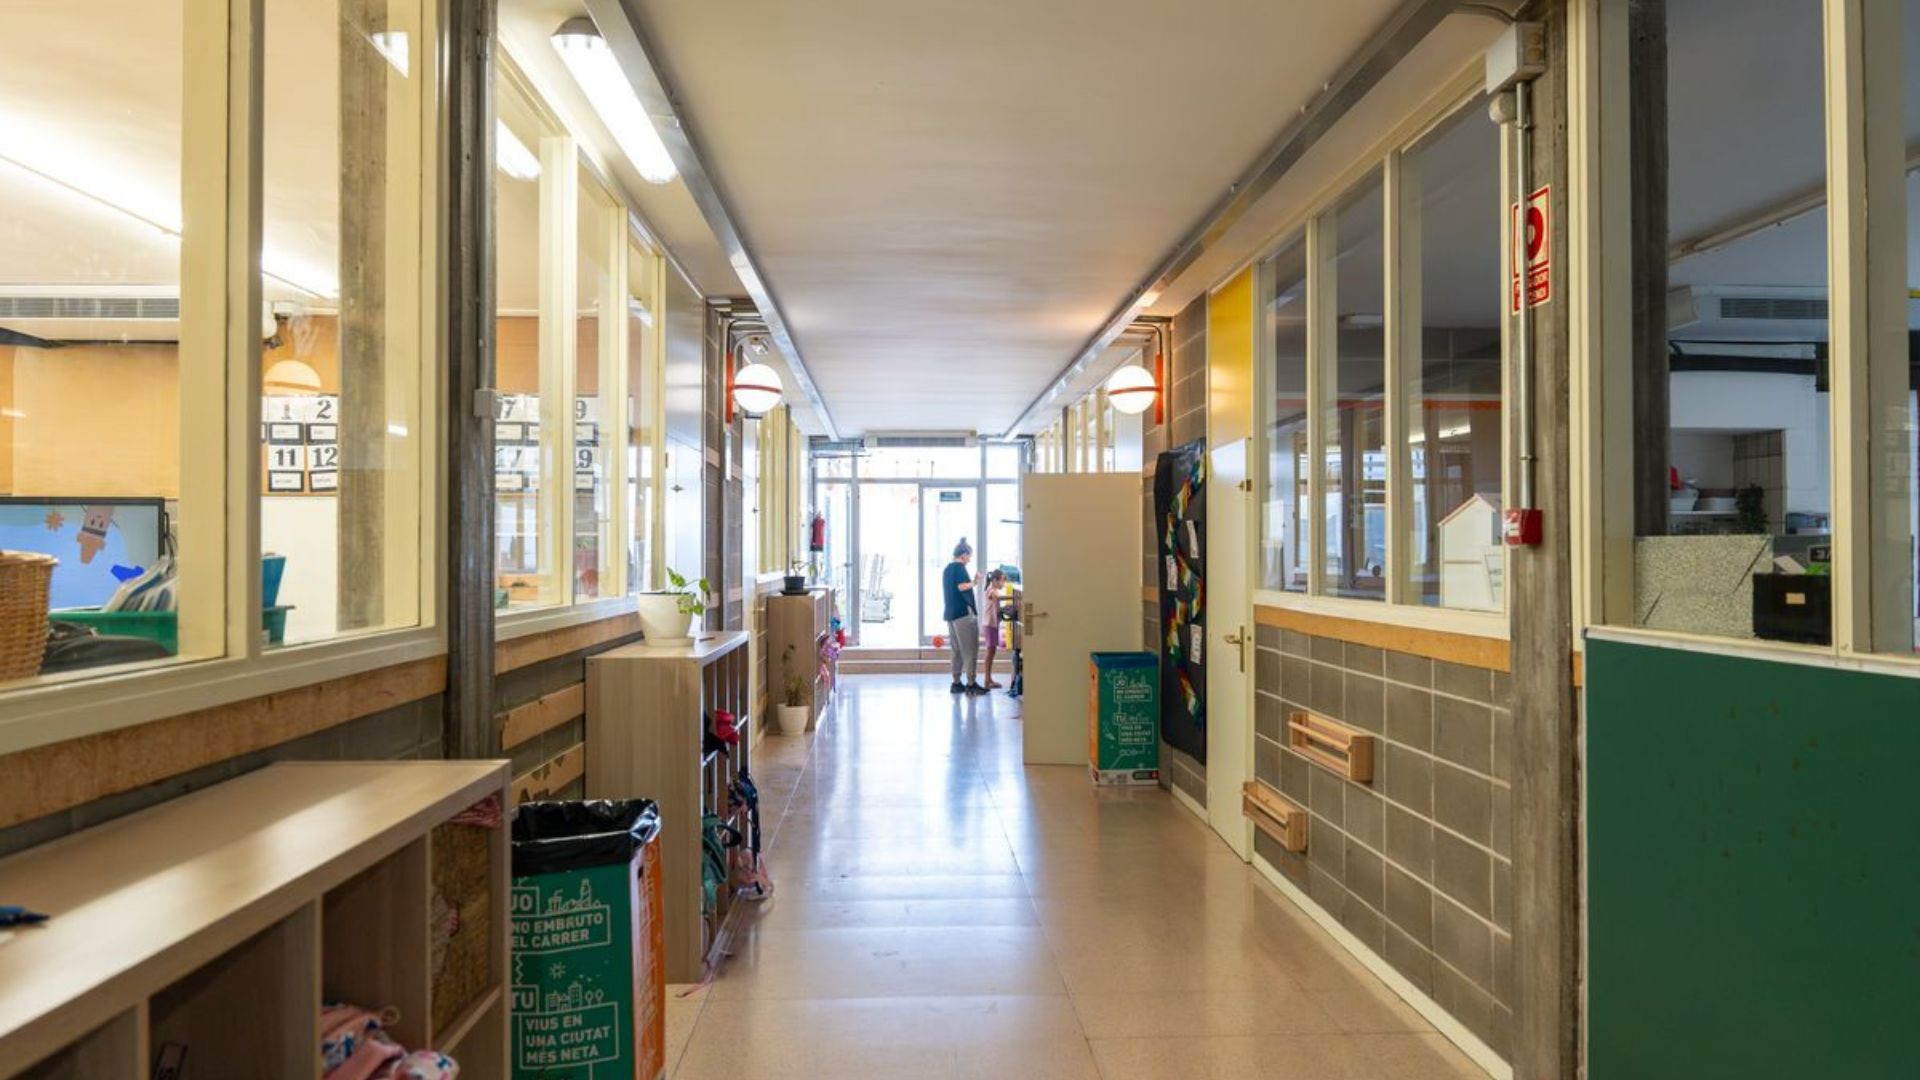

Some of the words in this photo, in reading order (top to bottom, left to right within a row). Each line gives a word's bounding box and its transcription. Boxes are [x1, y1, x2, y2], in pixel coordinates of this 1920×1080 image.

[316, 399, 332, 419] 2
[503, 399, 515, 419] 7
[275, 448, 296, 466] 11
[312, 446, 337, 468] 12
[534, 912, 604, 935] EMBRUTO
[512, 936, 529, 949] EL
[532, 928, 590, 949] CARRER
[512, 991, 534, 1009] TU
[526, 1017, 559, 1031] VIUS
[563, 1013, 583, 1028] EN
[526, 1034, 557, 1048] UNA
[561, 1025, 612, 1045] CIUTAT
[561, 1044, 600, 1061] NETA
